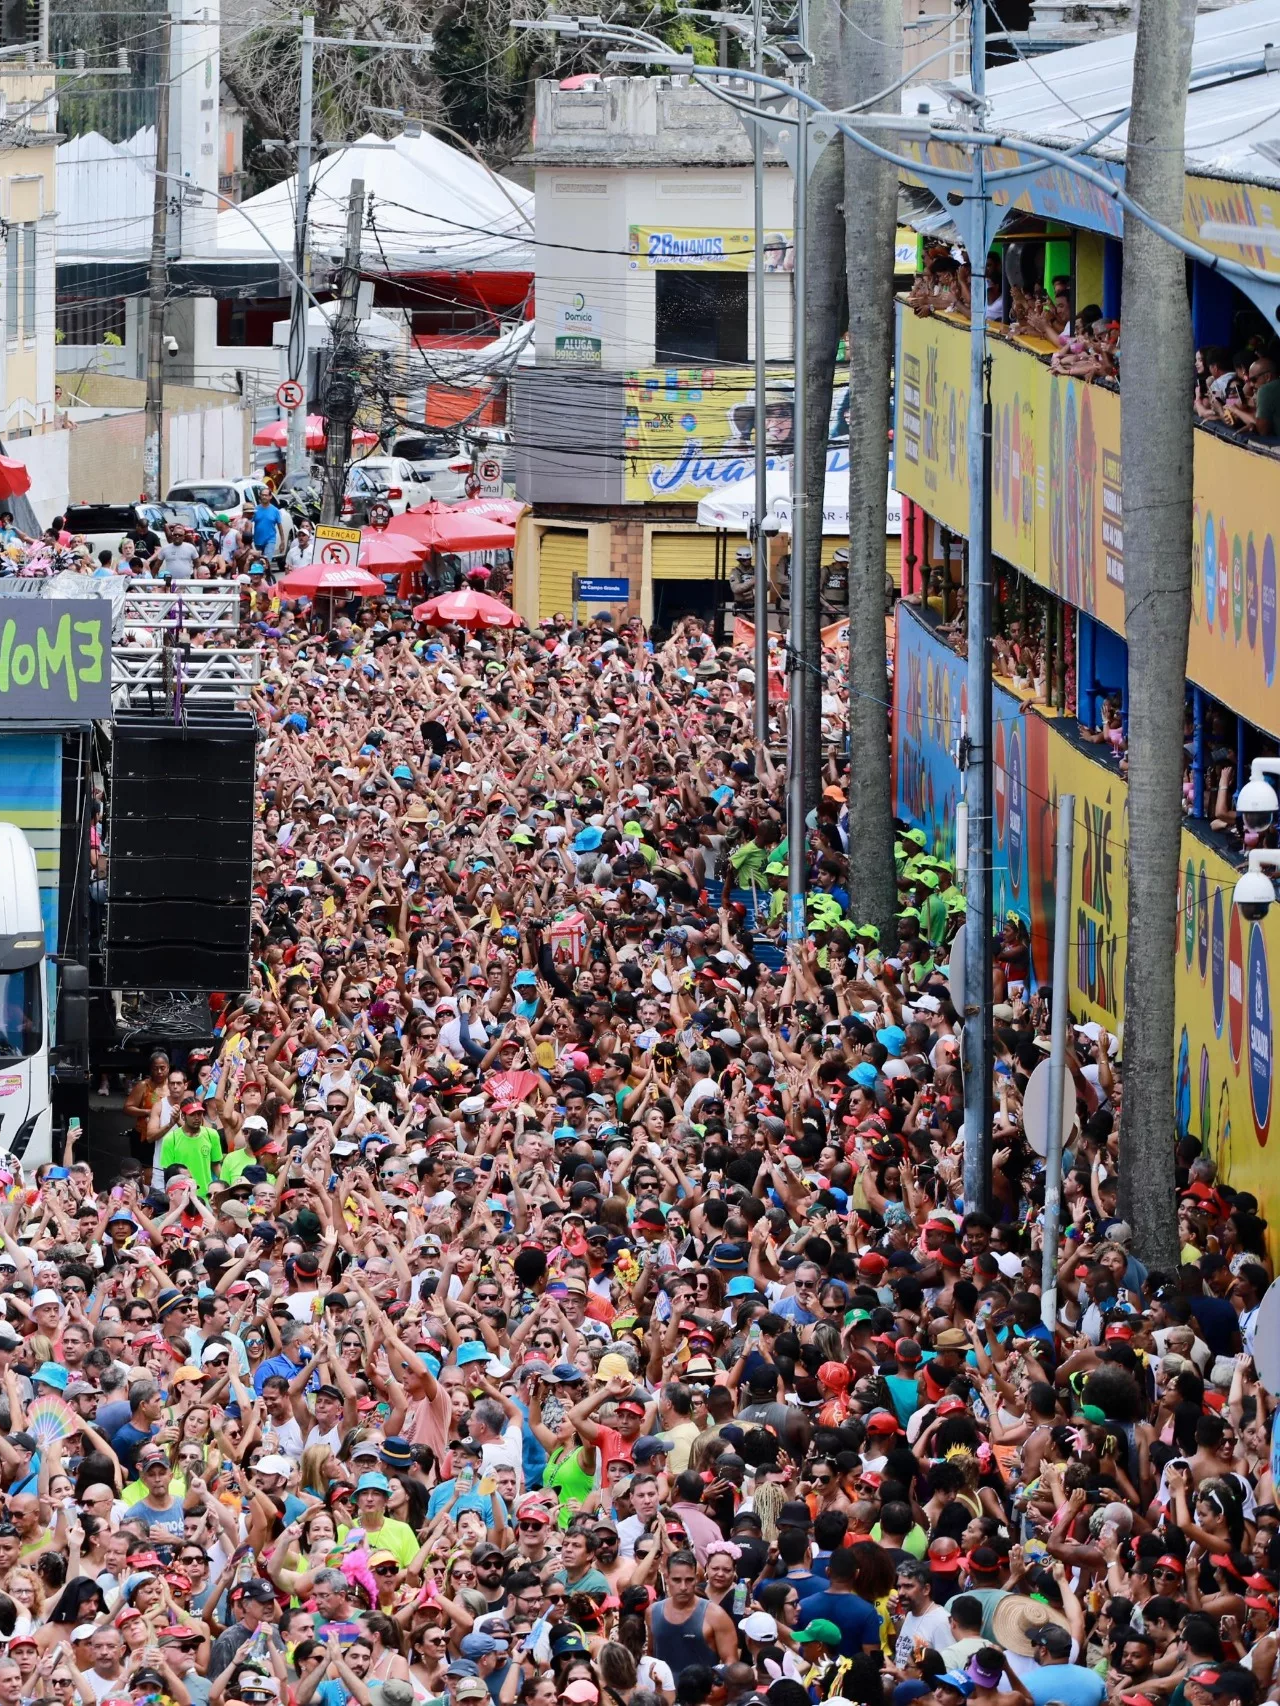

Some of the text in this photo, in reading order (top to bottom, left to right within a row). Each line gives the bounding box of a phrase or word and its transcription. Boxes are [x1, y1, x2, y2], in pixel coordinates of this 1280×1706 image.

[563, 338, 593, 351] ALUGA
[464, 503, 513, 515] BRAHMA
[321, 529, 356, 540] ATENÇÃO
